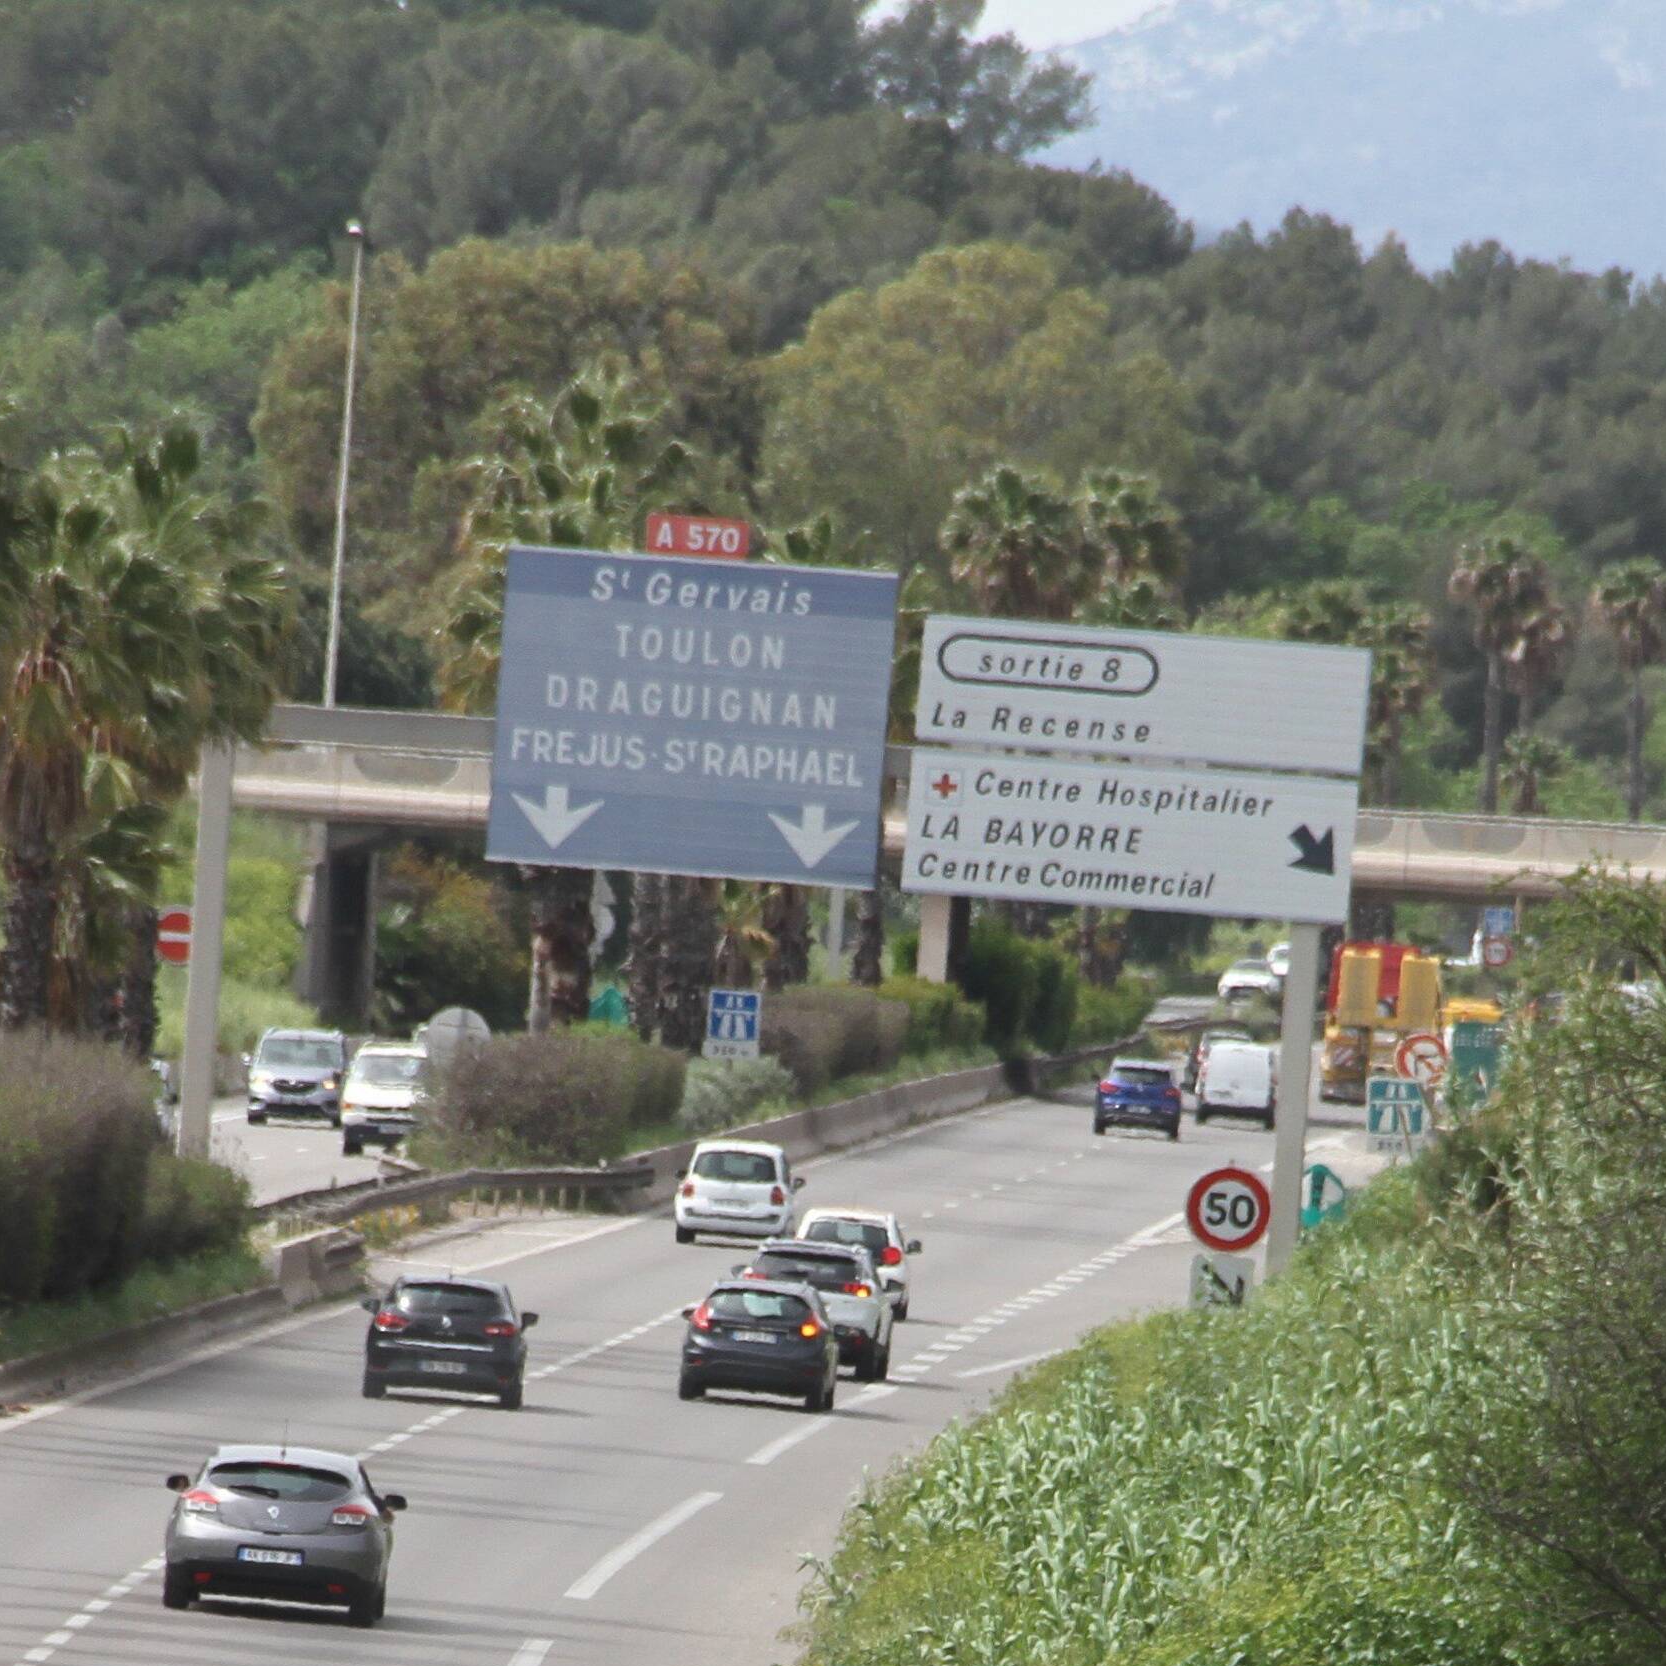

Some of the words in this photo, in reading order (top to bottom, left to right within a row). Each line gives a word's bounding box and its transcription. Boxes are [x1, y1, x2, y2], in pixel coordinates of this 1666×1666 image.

[655, 522, 673, 548] A
[687, 524, 740, 553] 570
[590, 567, 630, 602] St
[645, 572, 813, 616] Gervais
[616, 624, 785, 669] TOULON
[978, 653, 1085, 682] sortie
[1101, 658, 1121, 683] 8
[546, 674, 837, 730] DRAGUIGNAN
[932, 702, 966, 728] La
[991, 706, 1152, 744] Recense
[974, 771, 1081, 803] Centre
[1097, 779, 1274, 818] Hospitalier
[921, 814, 960, 841] LA
[983, 818, 1143, 855] BAYORRE
[917, 854, 1030, 884] Centre
[1040, 862, 1215, 898] Commercial
[1205, 1192, 1255, 1229] 50
